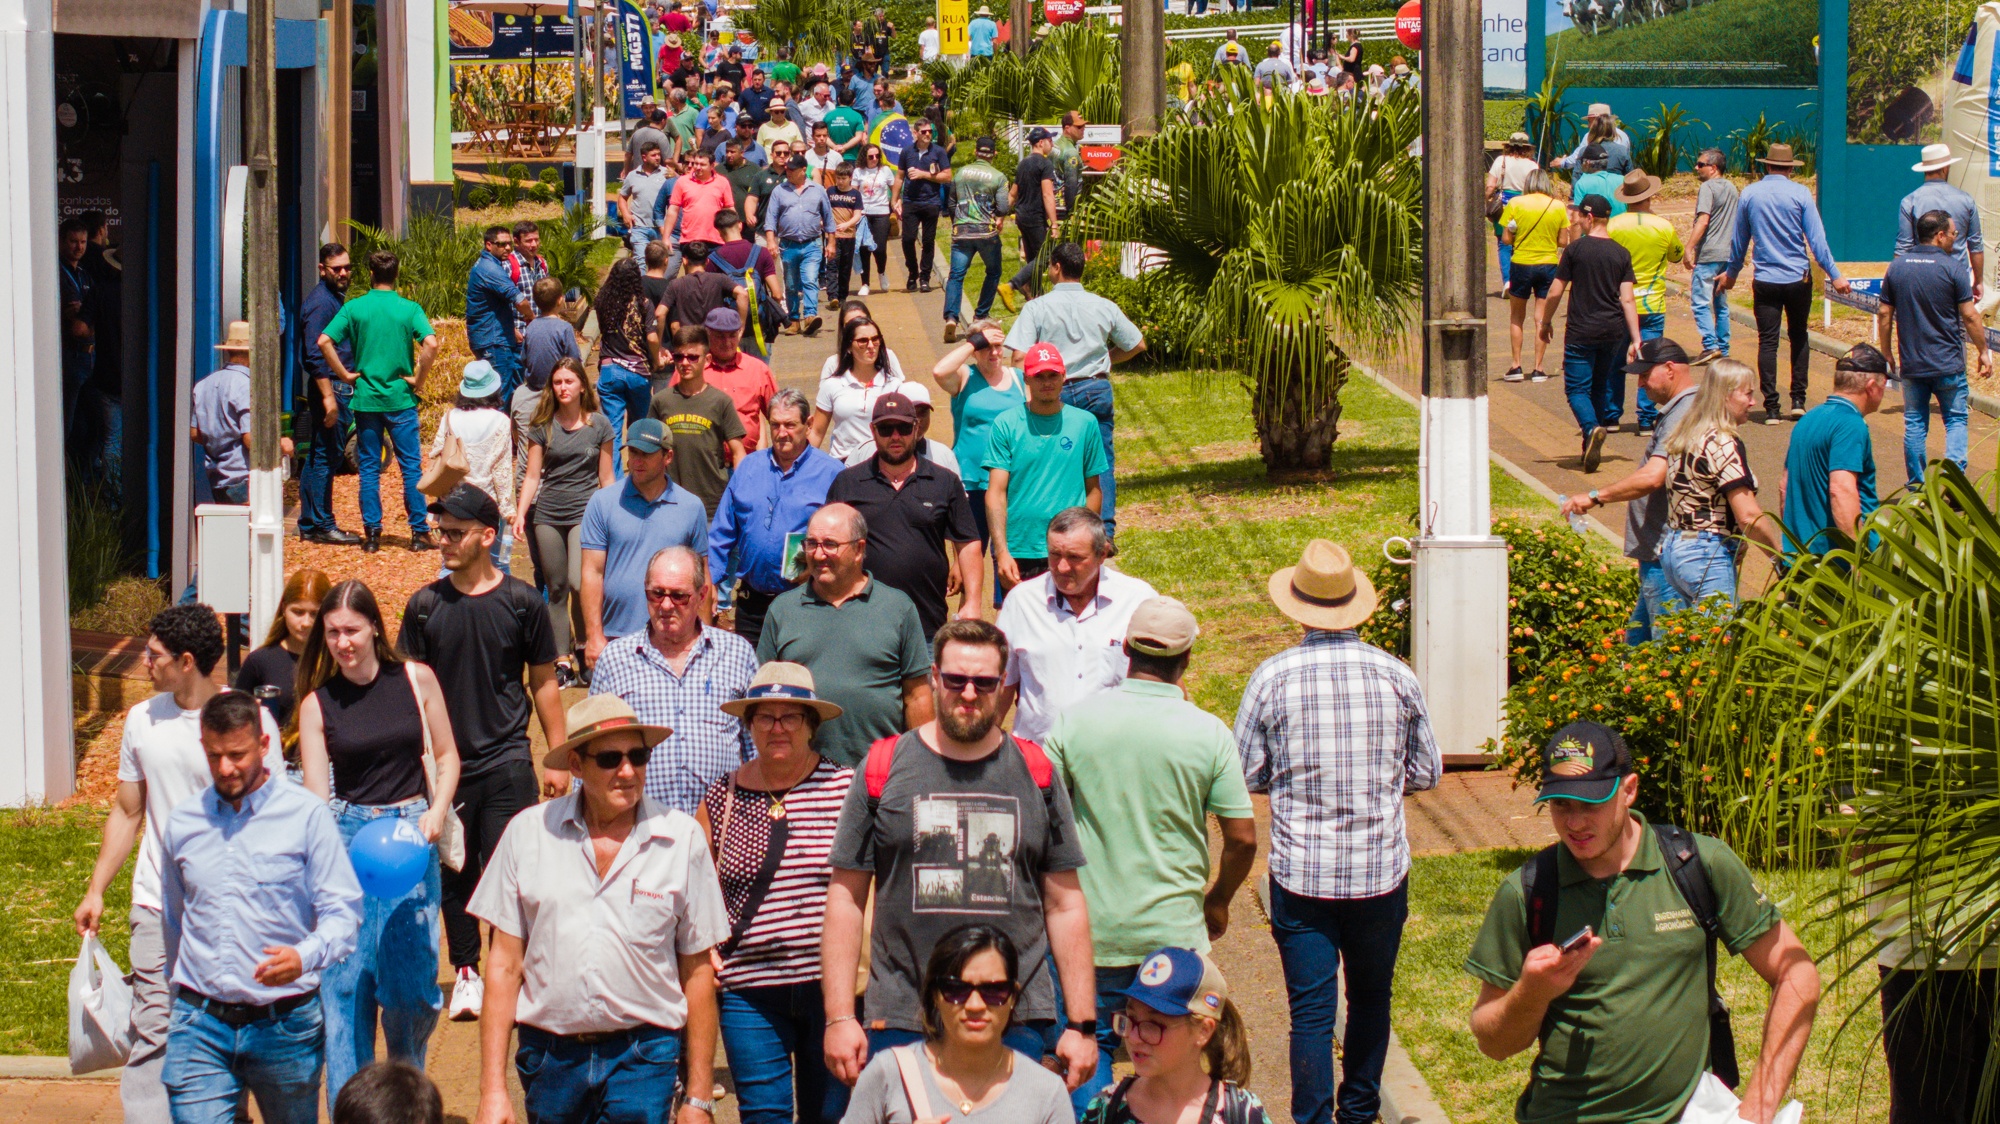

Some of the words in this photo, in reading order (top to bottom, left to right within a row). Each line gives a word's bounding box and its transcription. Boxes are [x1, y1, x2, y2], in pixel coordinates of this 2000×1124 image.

[942, 15, 966, 24] RUA
[1398, 21, 1421, 29] INTAC
[1483, 13, 1528, 33] nhe
[943, 27, 963, 43] 11
[625, 13, 644, 71] MG377
[1087, 150, 1113, 158] PLÁSTICO
[58, 196, 112, 207] panhadas
[105, 206, 119, 216] do
[1849, 280, 1871, 290] ASF
[685, 413, 713, 430] DEERE
[1654, 908, 1692, 921] ENGENHARIA
